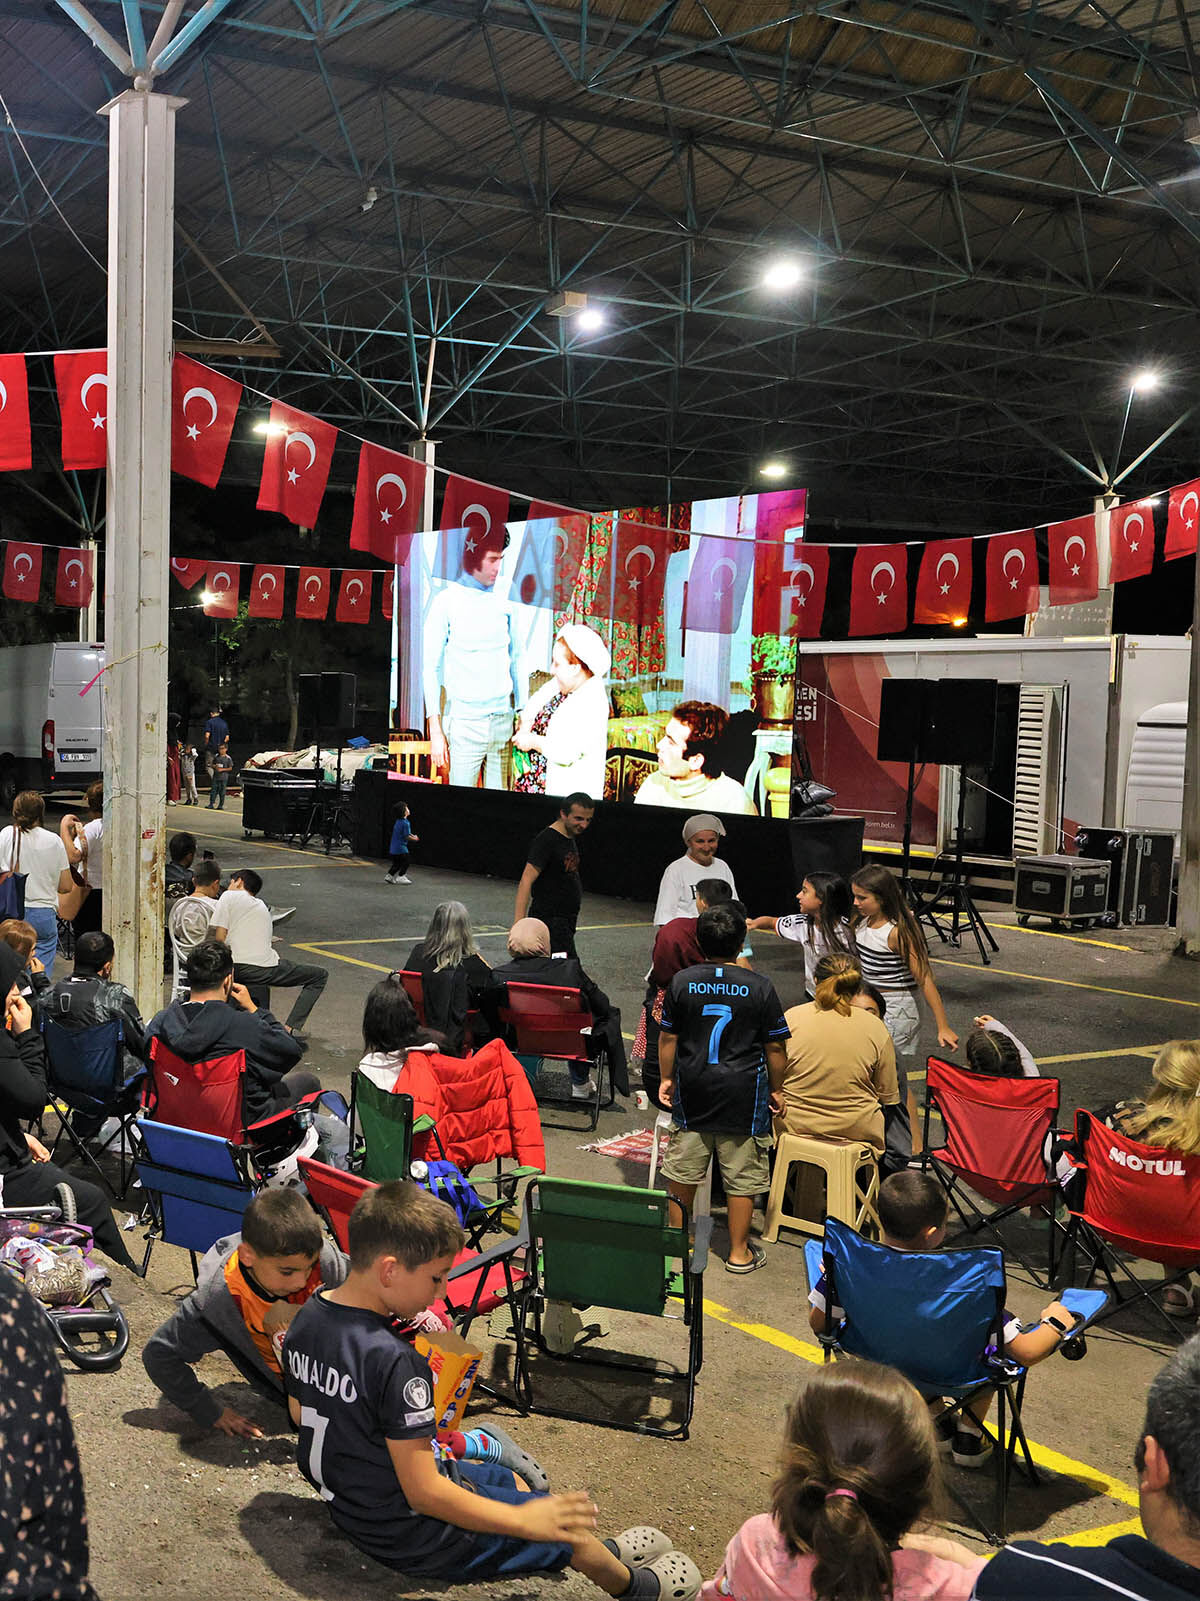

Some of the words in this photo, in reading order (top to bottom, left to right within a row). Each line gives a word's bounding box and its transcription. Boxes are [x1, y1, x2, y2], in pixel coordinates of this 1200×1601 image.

[688, 982, 750, 997] RONALDO
[701, 1003, 733, 1065] 7
[1108, 1146, 1186, 1176] MOTUL
[300, 1405, 335, 1502] 7
